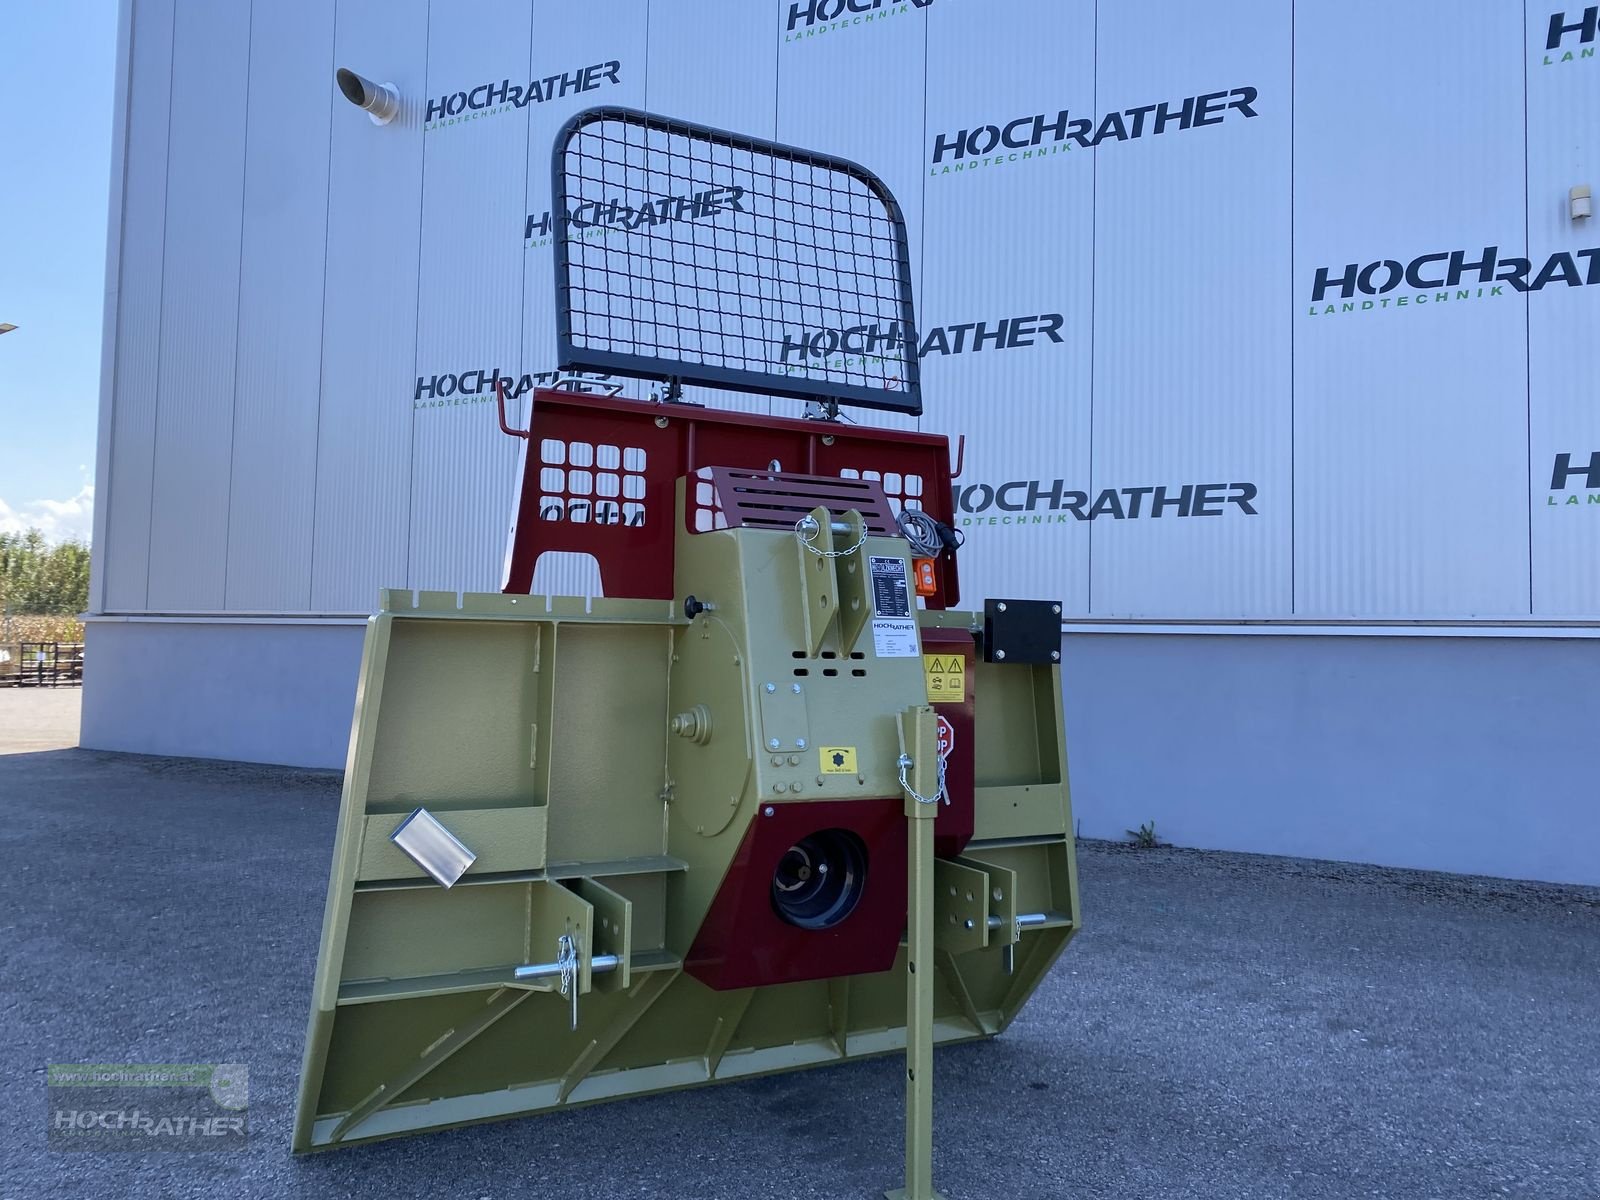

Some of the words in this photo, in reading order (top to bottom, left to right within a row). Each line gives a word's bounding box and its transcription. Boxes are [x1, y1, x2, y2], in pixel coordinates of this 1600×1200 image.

[785, 4, 908, 43] LANDTECHNIK
[1546, 6, 1600, 50] H
[425, 60, 621, 123] HOCHRATHER
[424, 104, 513, 131] LANDTECHNIK
[932, 86, 1259, 164] HOCHRATHER
[930, 142, 1072, 176] LANDTECHNIK
[1309, 286, 1503, 316] LANDTECHNIK
